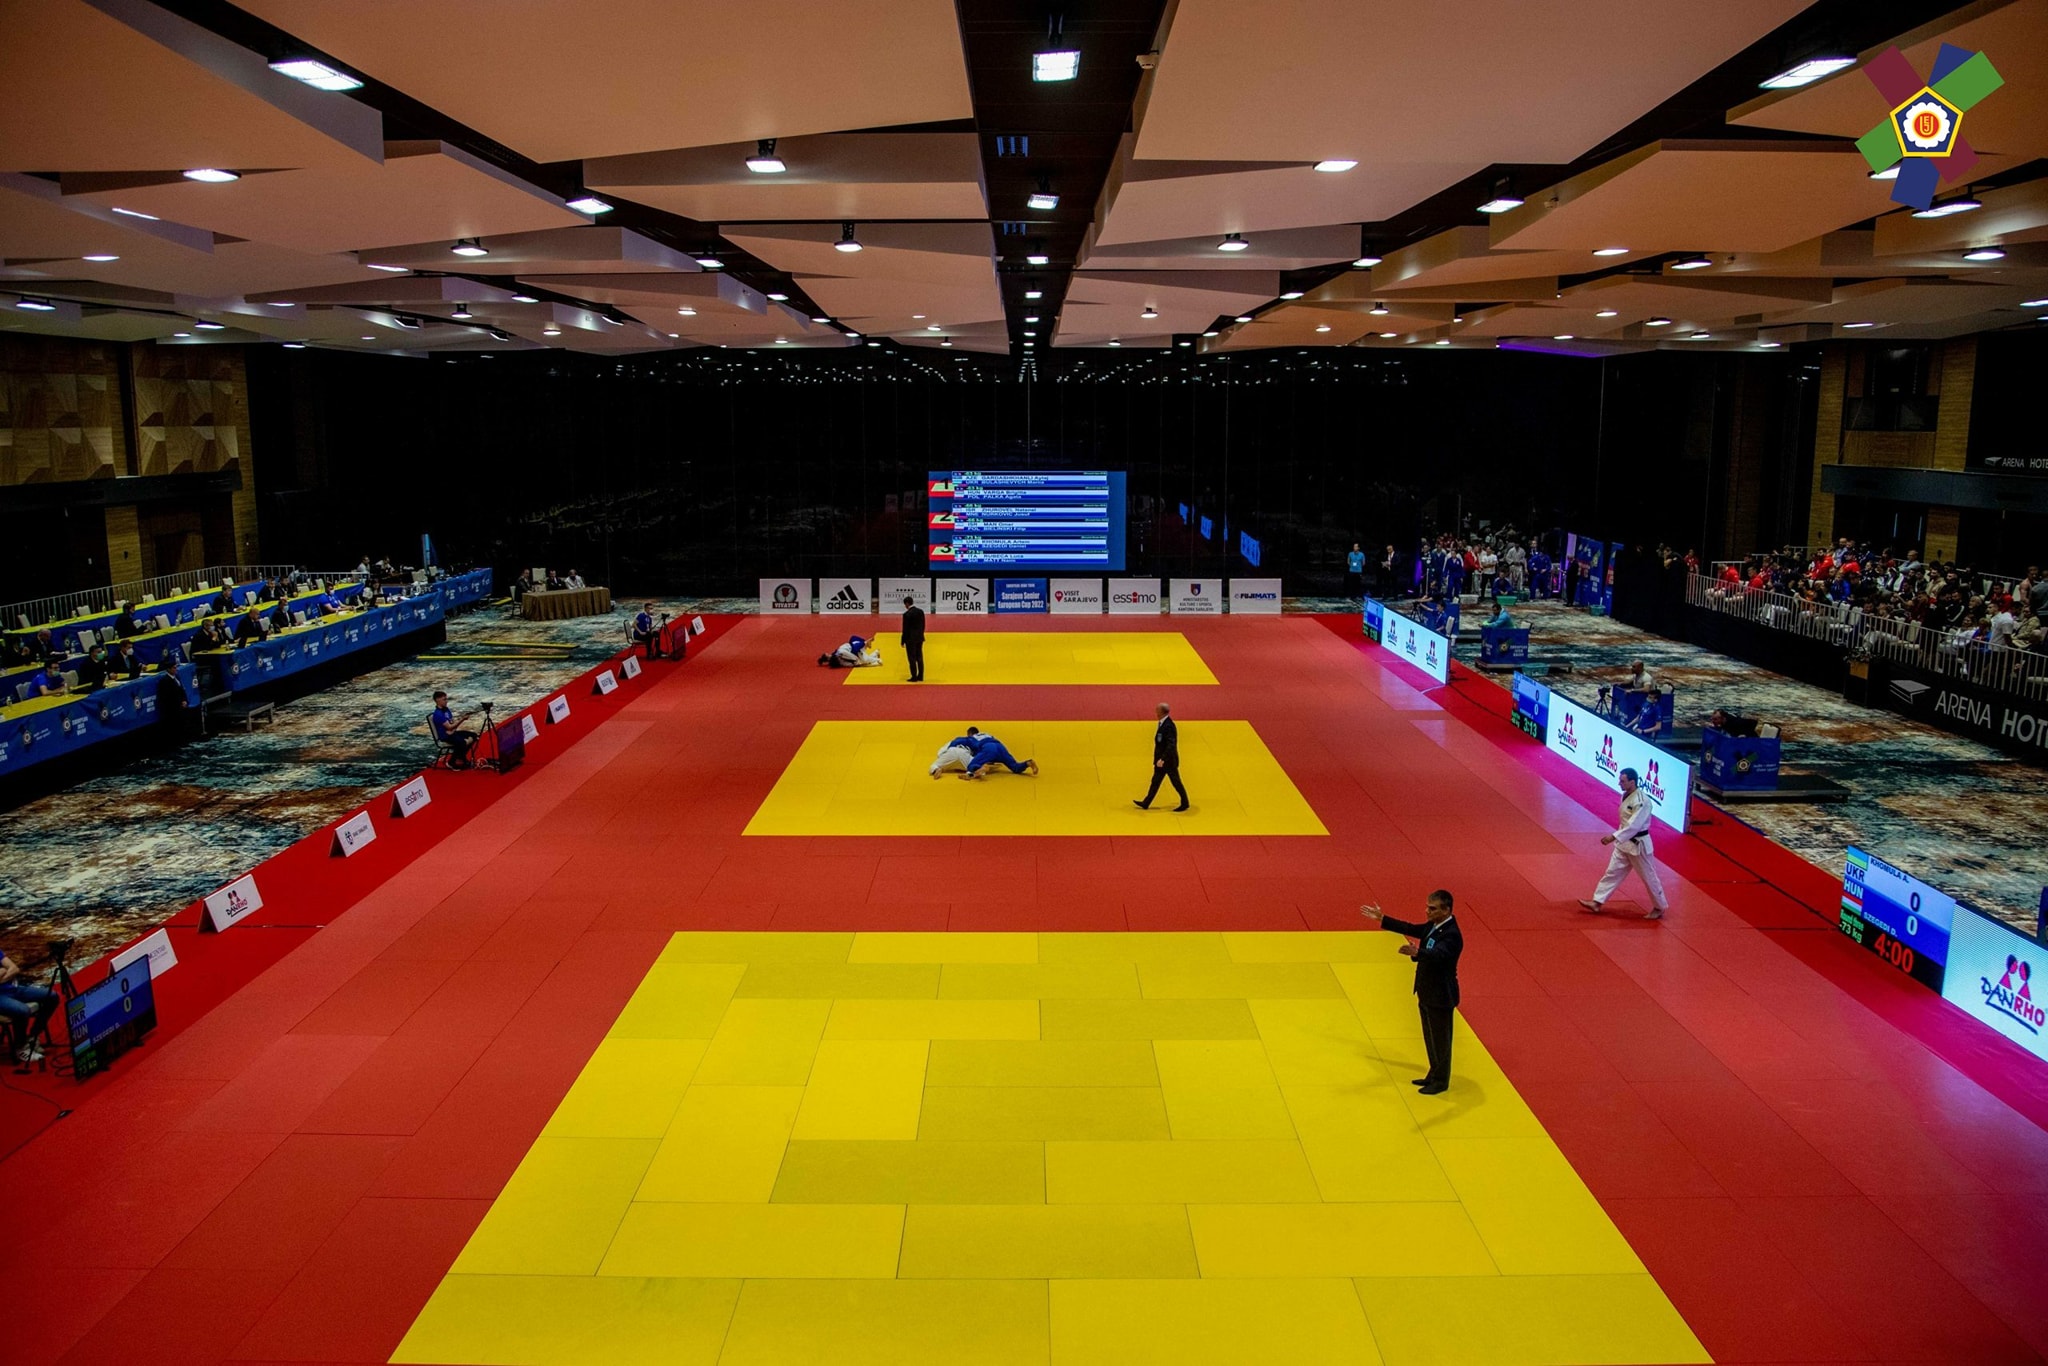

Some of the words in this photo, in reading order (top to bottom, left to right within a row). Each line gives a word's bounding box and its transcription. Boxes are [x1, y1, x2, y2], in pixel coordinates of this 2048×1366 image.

[2002, 457, 2025, 468] ARENA
[940, 478, 949, 490] 1
[940, 510, 952, 522] 2
[940, 544, 952, 554] 3
[942, 590, 970, 601] IPPON
[1001, 591, 1024, 601] Sarajevo
[1024, 591, 1040, 600] Senior
[1112, 591, 1157, 604] essimo
[1240, 592, 1277, 600] FUJIMATS
[826, 599, 865, 611] adidas
[956, 601, 982, 612] GEAR
[997, 601, 1021, 610] European
[1021, 600, 1032, 610] Cup
[1032, 600, 1044, 609] 2022
[1535, 689, 1540, 702] 0
[1534, 703, 1539, 716] 0
[1934, 690, 1992, 730] ARENA
[1523, 717, 1538, 739] 3:13
[1558, 728, 1578, 749] DANRHO
[1595, 750, 1618, 773] DANRHO
[1638, 776, 1665, 802] DANRHO
[1845, 862, 1865, 882] UKR
[1869, 857, 1902, 880] KHOMULA
[1843, 879, 1864, 900] HUN
[225, 898, 248, 916] DANRHO
[1909, 891, 1921, 913] 0
[1863, 911, 1891, 932] SZEGEDI
[1906, 915, 1919, 936] 0
[1852, 926, 1863, 944] kg
[1873, 932, 1915, 974] 4:00
[121, 977, 130, 994] 0
[123, 996, 132, 1013] 0
[1980, 975, 2046, 1028] DANRHO
